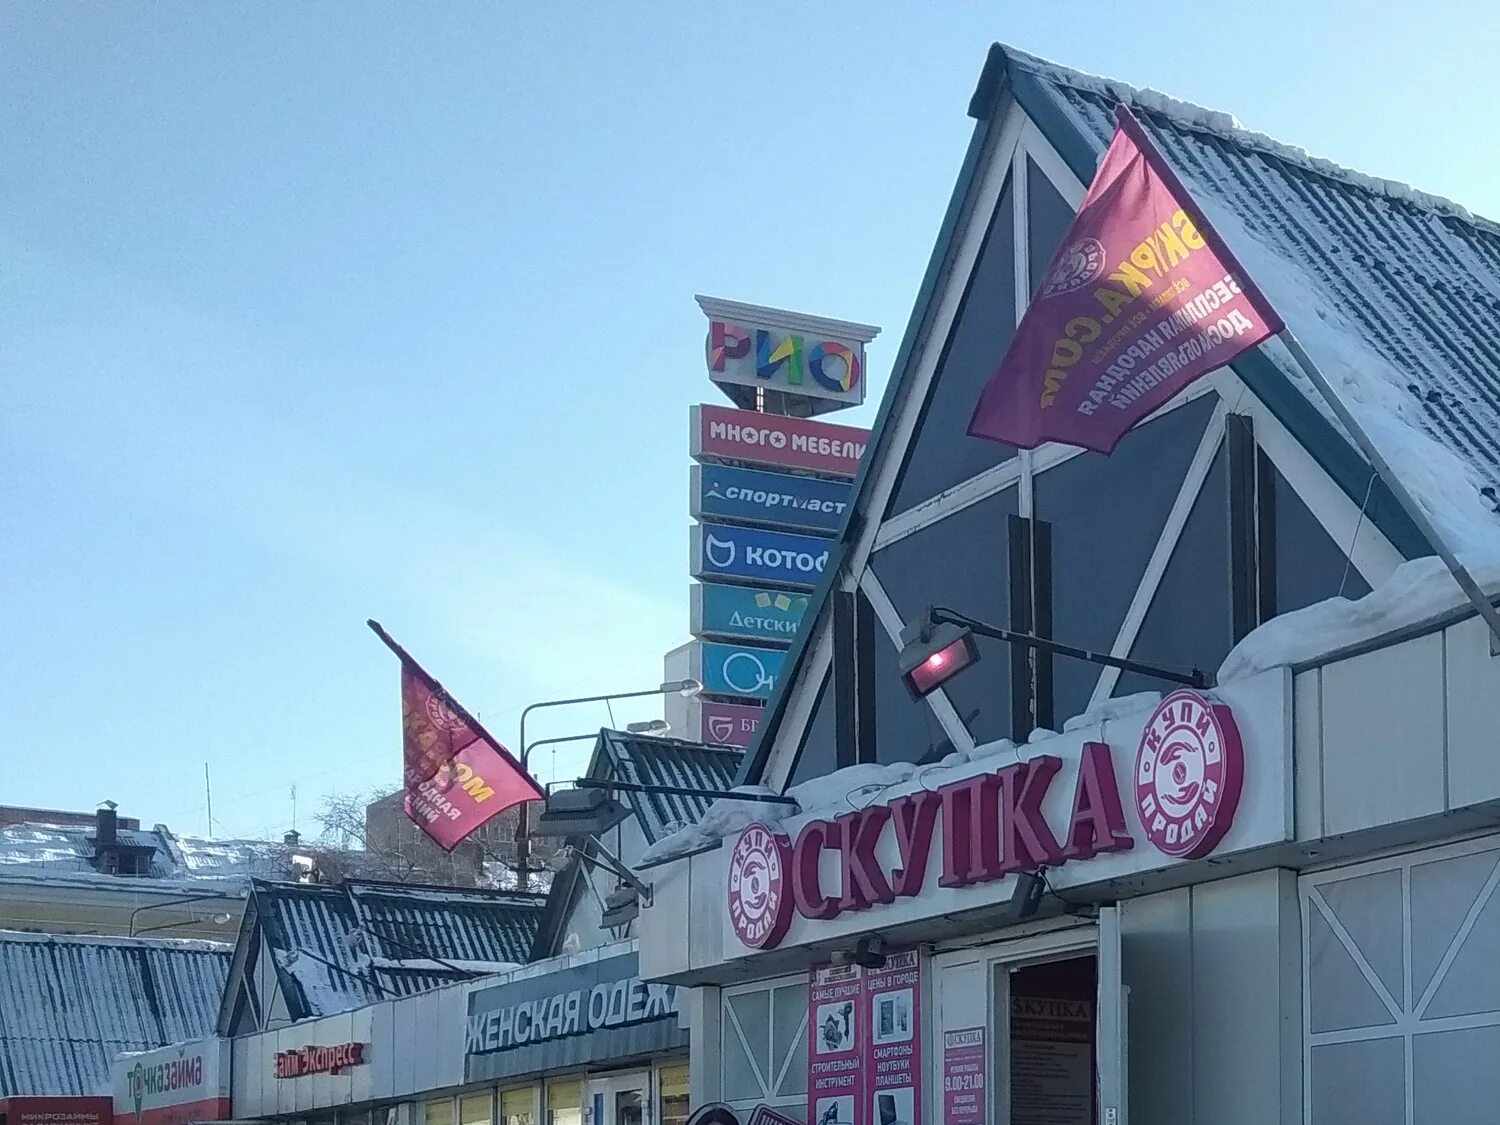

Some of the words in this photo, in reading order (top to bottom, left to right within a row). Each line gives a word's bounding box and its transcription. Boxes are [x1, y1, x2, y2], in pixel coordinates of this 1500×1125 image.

[711, 321, 860, 392] РИО
[710, 421, 787, 448] МНОГО
[728, 611, 800, 633] Детски
[1146, 701, 1211, 754] КУПИ
[1141, 778, 1218, 845] ПРОДАЙ
[793, 742, 1134, 921] СКУПКА
[735, 831, 774, 868] КУПИ
[732, 891, 778, 939] ПРОДАЙ
[812, 987, 834, 1001] САМЫЕ
[835, 983, 861, 998] ЛУЧШИЕ
[868, 977, 886, 991] ЦЕНЫ
[893, 971, 919, 985] ГОРОДЕ
[466, 990, 582, 1052] ЖЕНСКАЯ
[811, 1056, 860, 1074] СТРОИТЕЛЬНЫЙ
[877, 1060, 910, 1072] НОУТБУКИ
[815, 1075, 855, 1089] ИНСТРУМЕНТ
[875, 1073, 912, 1086] ПЛАНШЕТЫ
